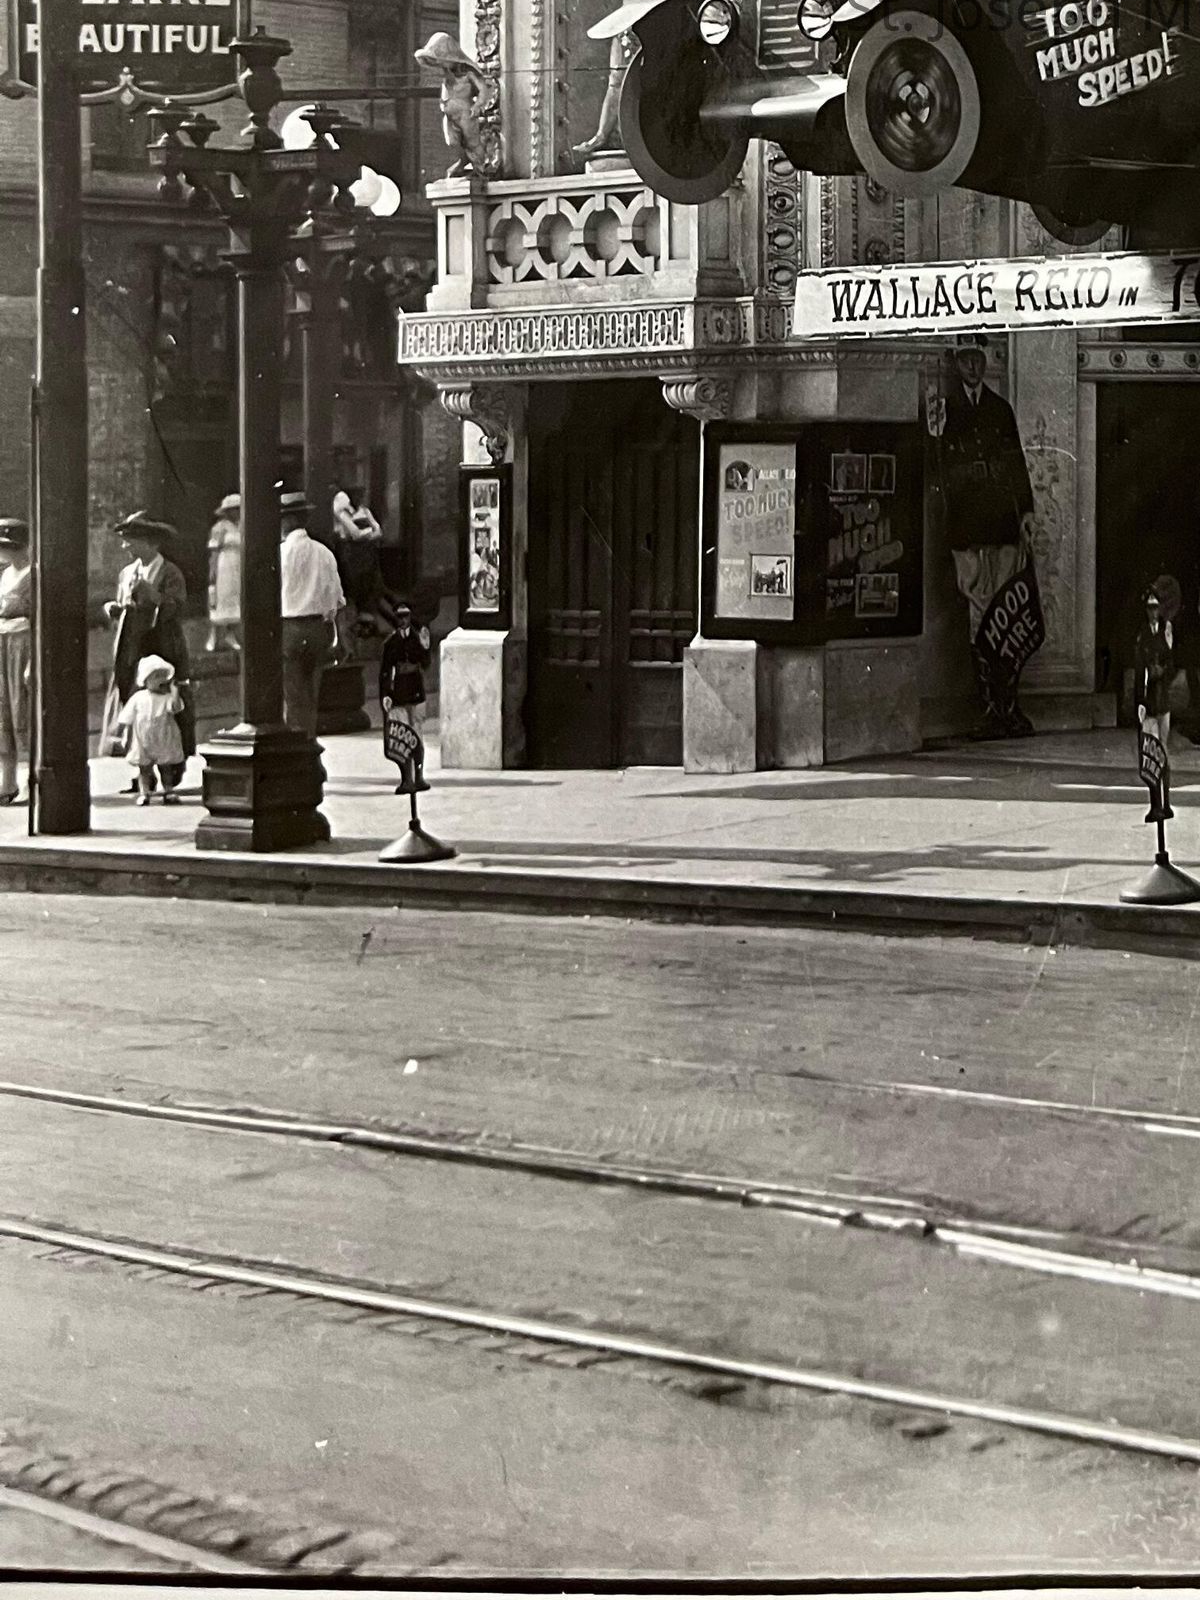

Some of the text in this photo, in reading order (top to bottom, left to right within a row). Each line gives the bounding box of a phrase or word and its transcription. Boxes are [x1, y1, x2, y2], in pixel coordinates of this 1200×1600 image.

[25, 23, 230, 55] BAUTIFUL
[1036, 27, 1116, 81] MUCH
[1078, 31, 1173, 107] SPEED!
[827, 271, 997, 323] WALLACE
[1014, 266, 1113, 314] REID
[1119, 286, 1139, 307] IN
[984, 581, 1030, 651] HOOD
[1000, 608, 1038, 659] TIRE
[389, 722, 418, 749] HOOD
